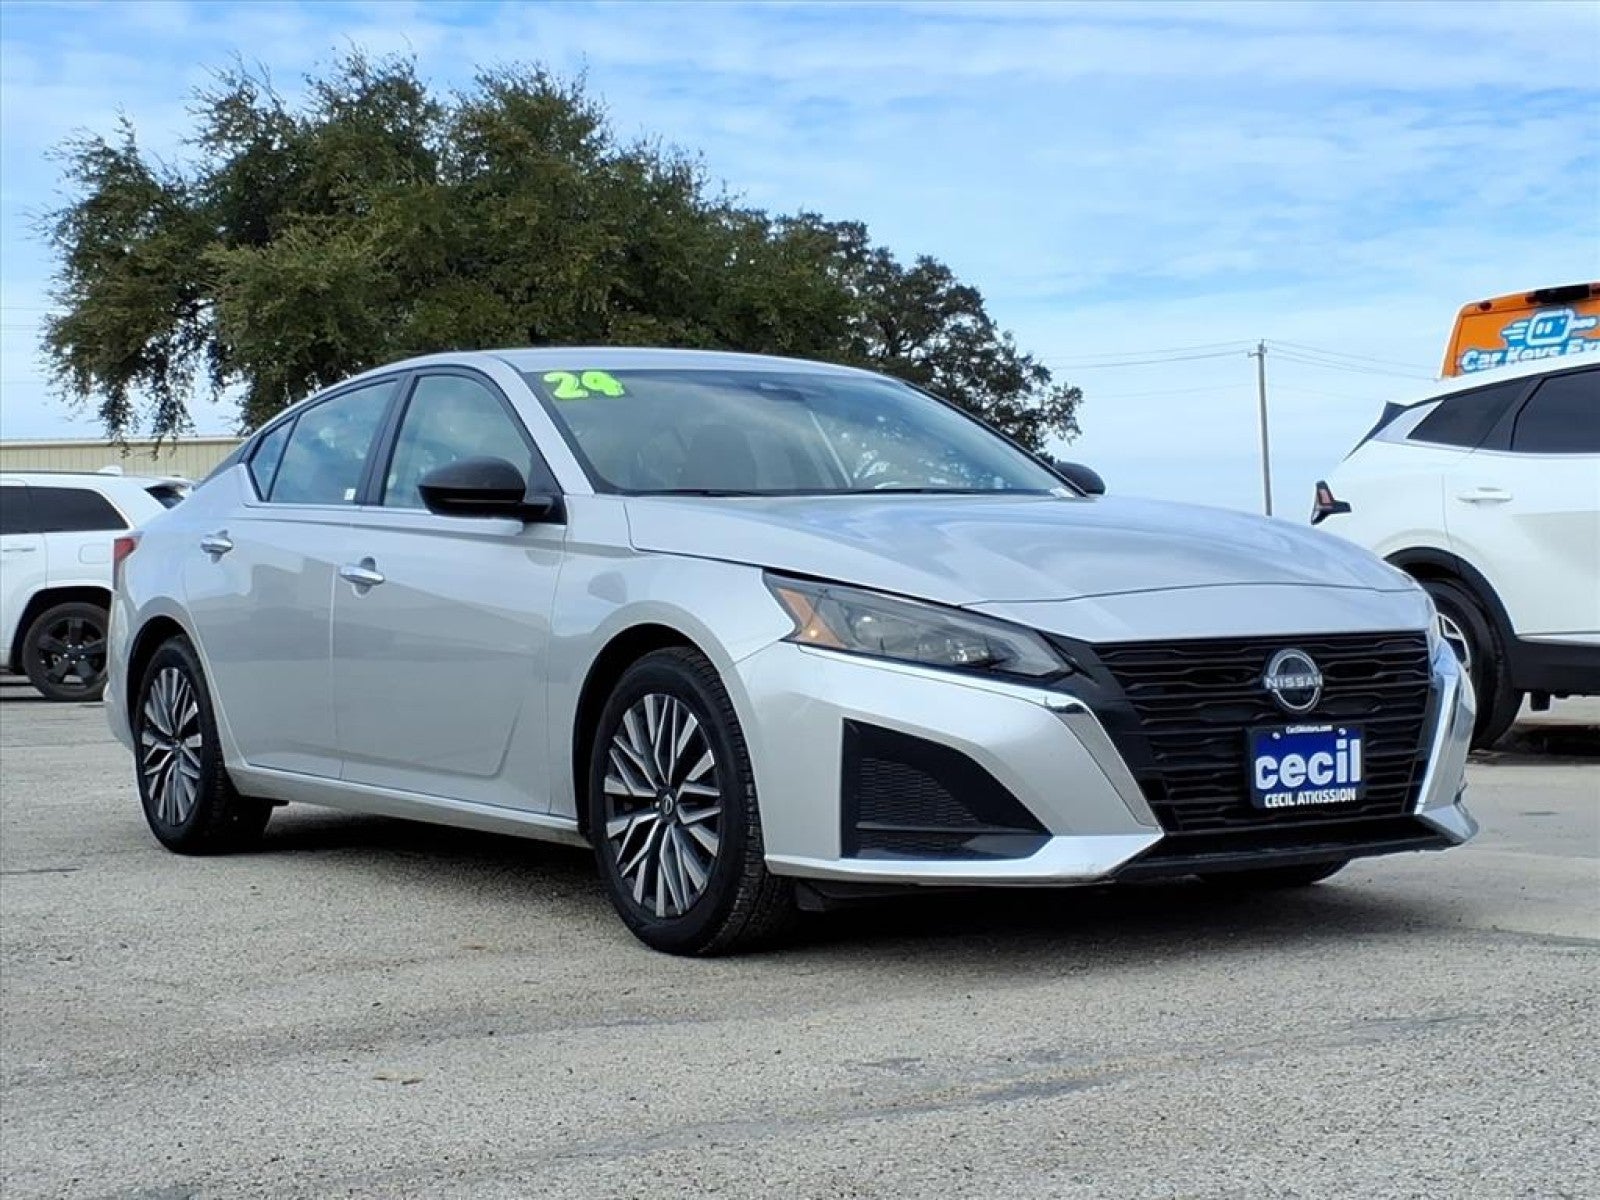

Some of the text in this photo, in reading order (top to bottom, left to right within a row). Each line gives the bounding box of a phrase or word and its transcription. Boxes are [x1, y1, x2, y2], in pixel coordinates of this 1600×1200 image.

[1461, 350, 1502, 371] Car
[1264, 674, 1323, 690] NISSAN
[1255, 738, 1362, 790] cecil
[1265, 788, 1357, 808] CECIL ATKISSION
